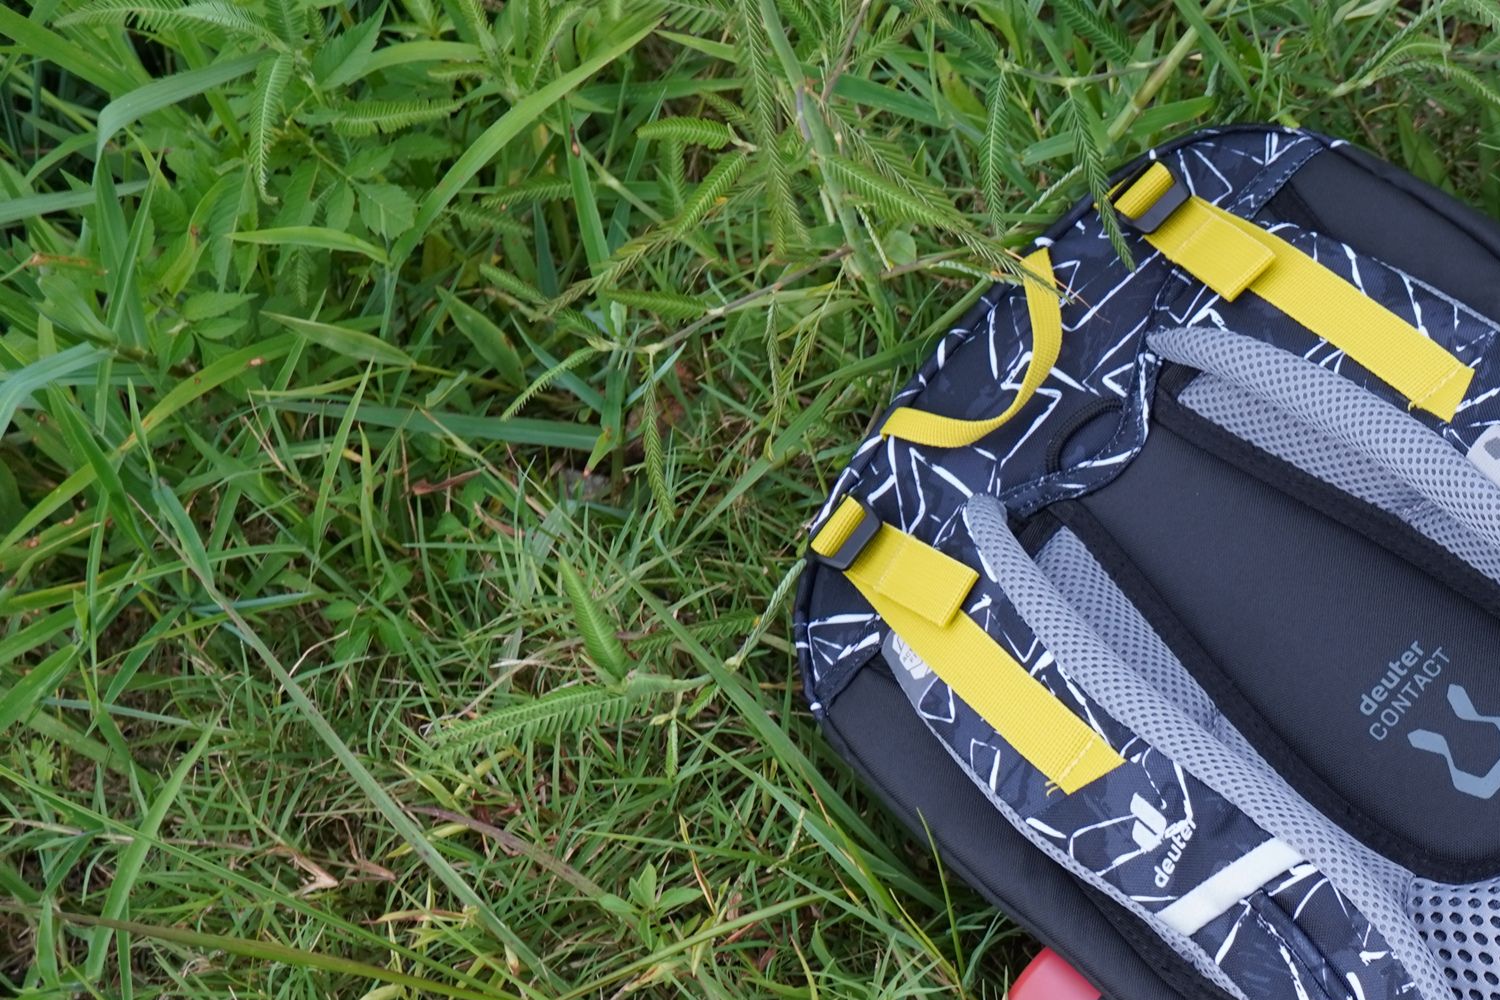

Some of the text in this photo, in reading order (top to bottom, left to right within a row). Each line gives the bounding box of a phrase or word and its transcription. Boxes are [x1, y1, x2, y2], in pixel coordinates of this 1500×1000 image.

[1360, 641, 1424, 716] deuter
[1369, 647, 1450, 741] CONTACT
[1155, 820, 1196, 888] deuter
